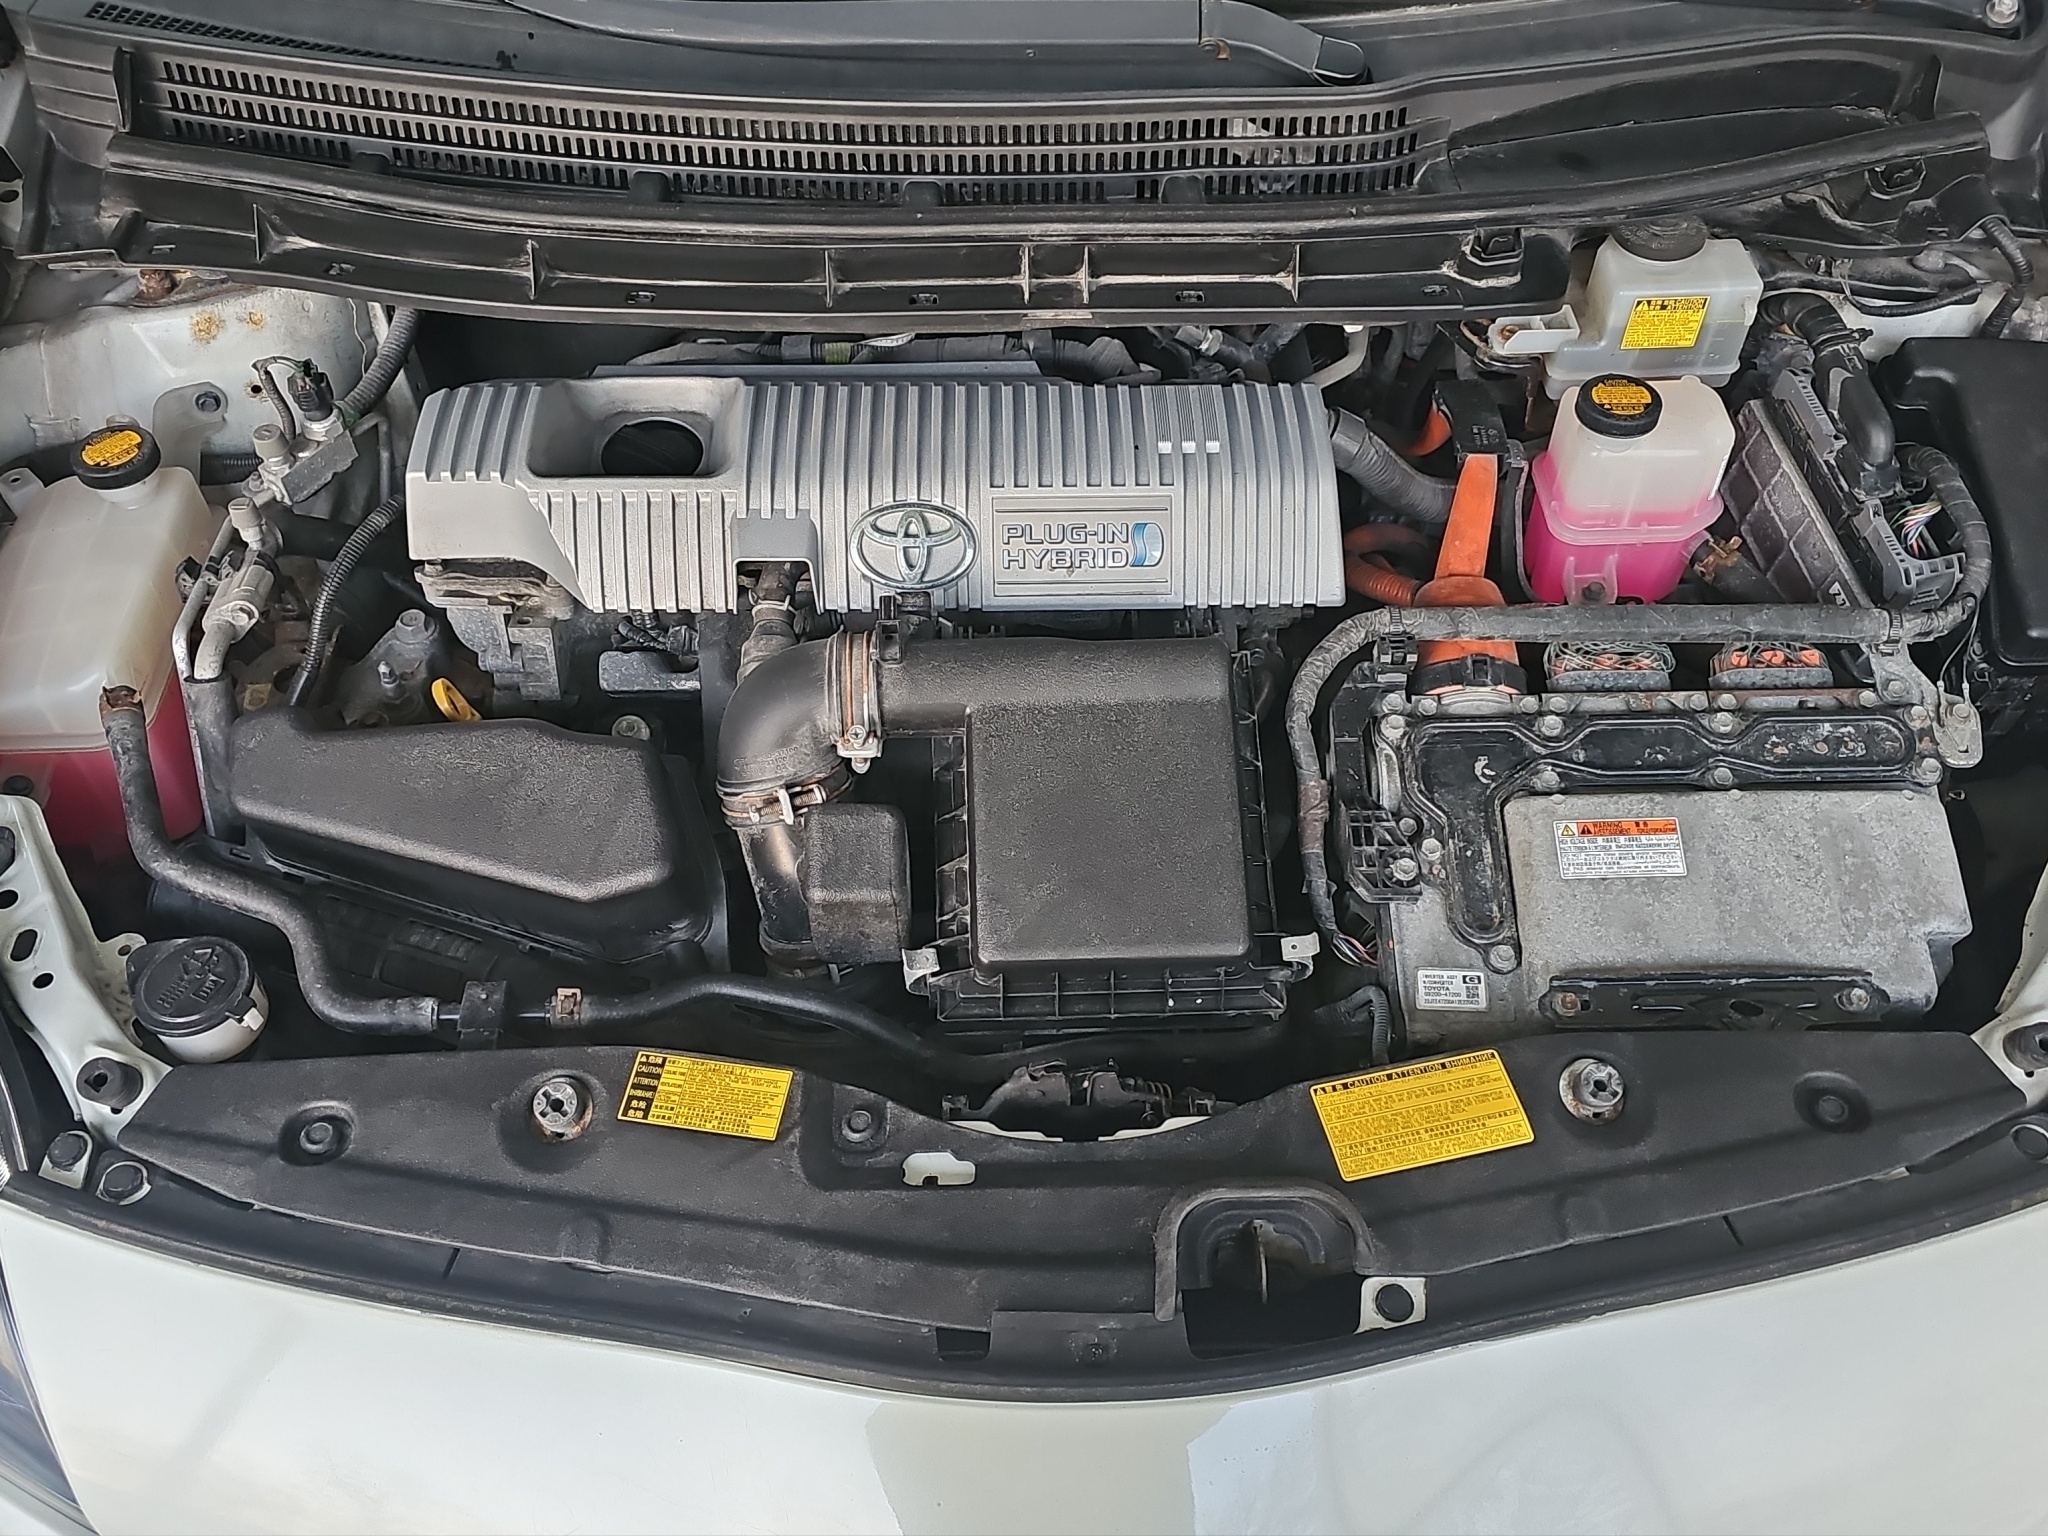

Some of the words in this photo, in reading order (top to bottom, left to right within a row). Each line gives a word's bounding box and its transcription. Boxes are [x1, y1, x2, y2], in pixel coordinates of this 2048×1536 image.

[1002, 522, 1129, 545] PLUG-IN
[1003, 547, 1129, 570] HYBRID
[637, 1064, 664, 1074] CAUTION
[1347, 1074, 1388, 1089] CAUTION
[1391, 1063, 1443, 1080] ATTENTION
[1445, 1052, 1495, 1069] ВНИМАНИЕ
[633, 1077, 659, 1086] ATTENTION
[1339, 1148, 1363, 1159] READY
